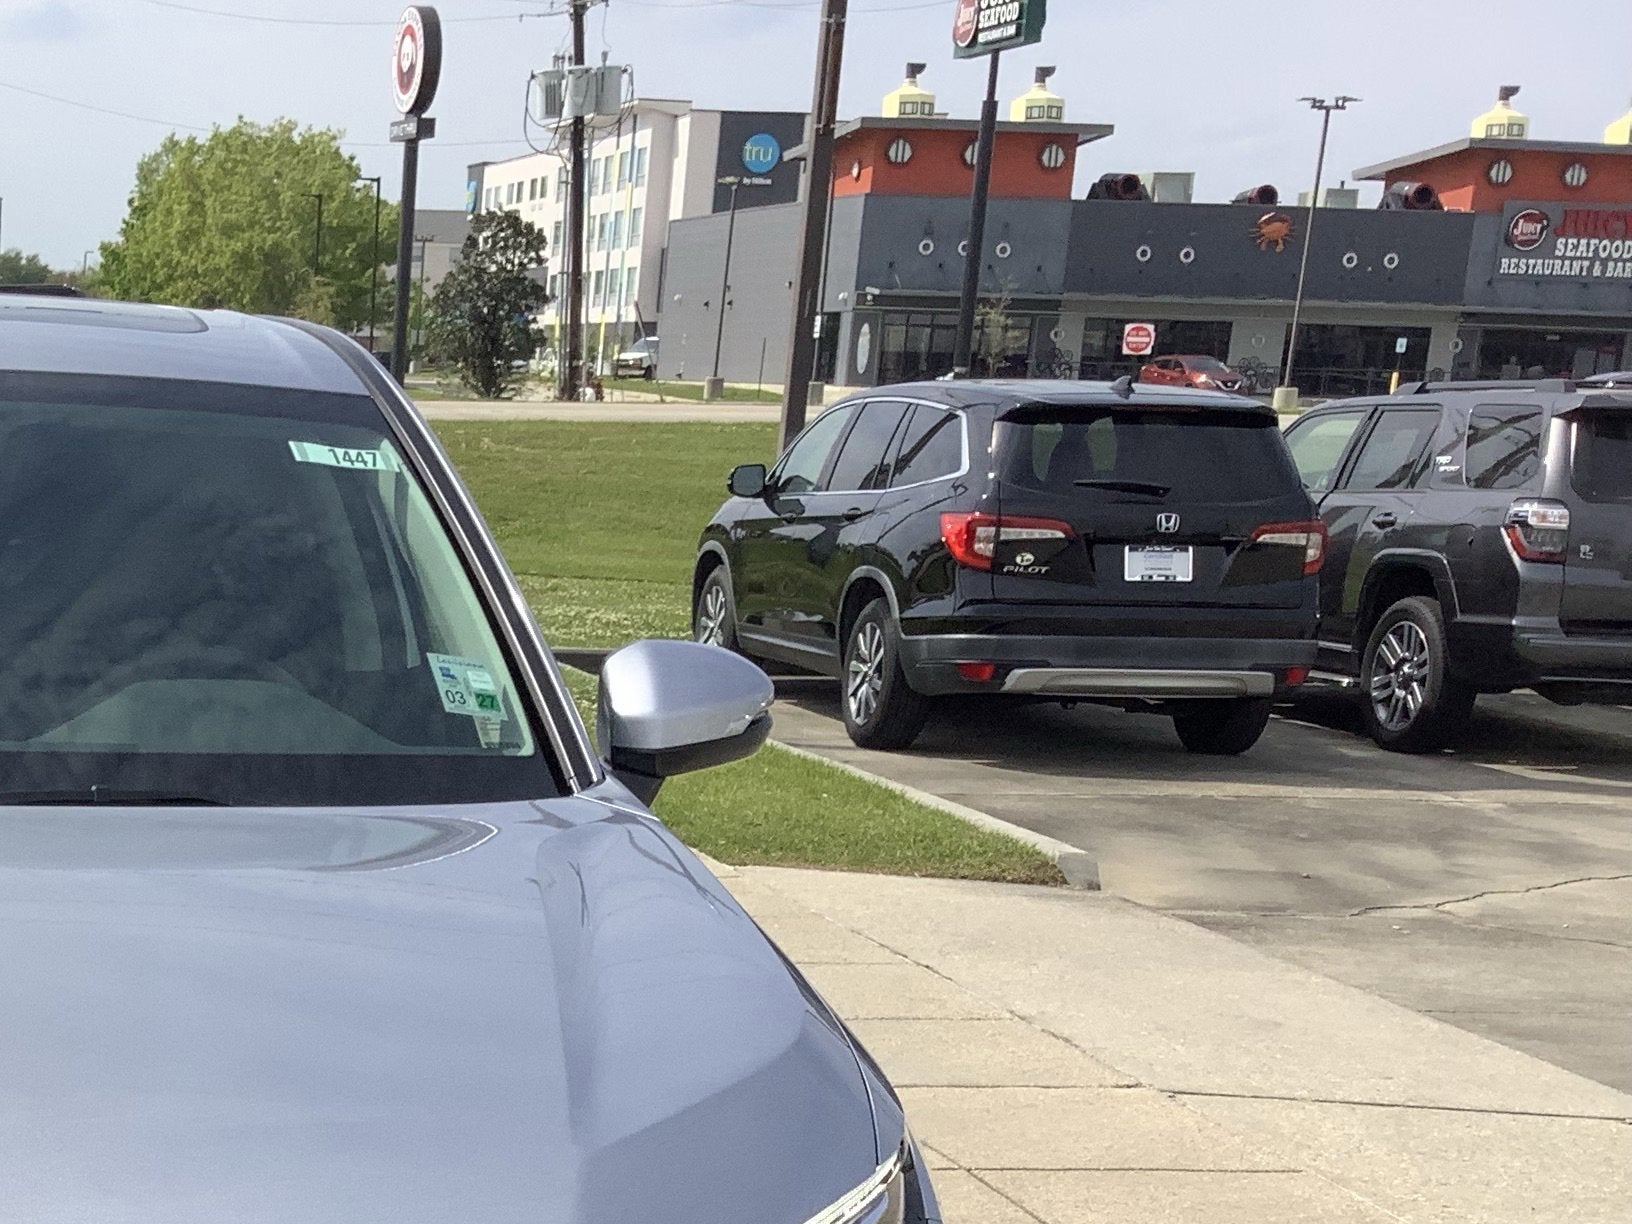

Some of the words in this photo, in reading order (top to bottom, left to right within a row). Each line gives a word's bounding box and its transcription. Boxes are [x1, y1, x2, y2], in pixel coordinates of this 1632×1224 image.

[978, 1, 1020, 29] SEAFOOD
[744, 142, 773, 162] tru
[1555, 237, 1632, 259] SEAFOOD
[1499, 258, 1590, 276] RESTAURANT
[1592, 261, 1602, 277] &
[1605, 261, 1632, 278] BAR
[328, 448, 378, 468] 1447
[1003, 565, 1051, 575] PILOT
[445, 689, 467, 705] 03
[476, 693, 496, 709] 27
